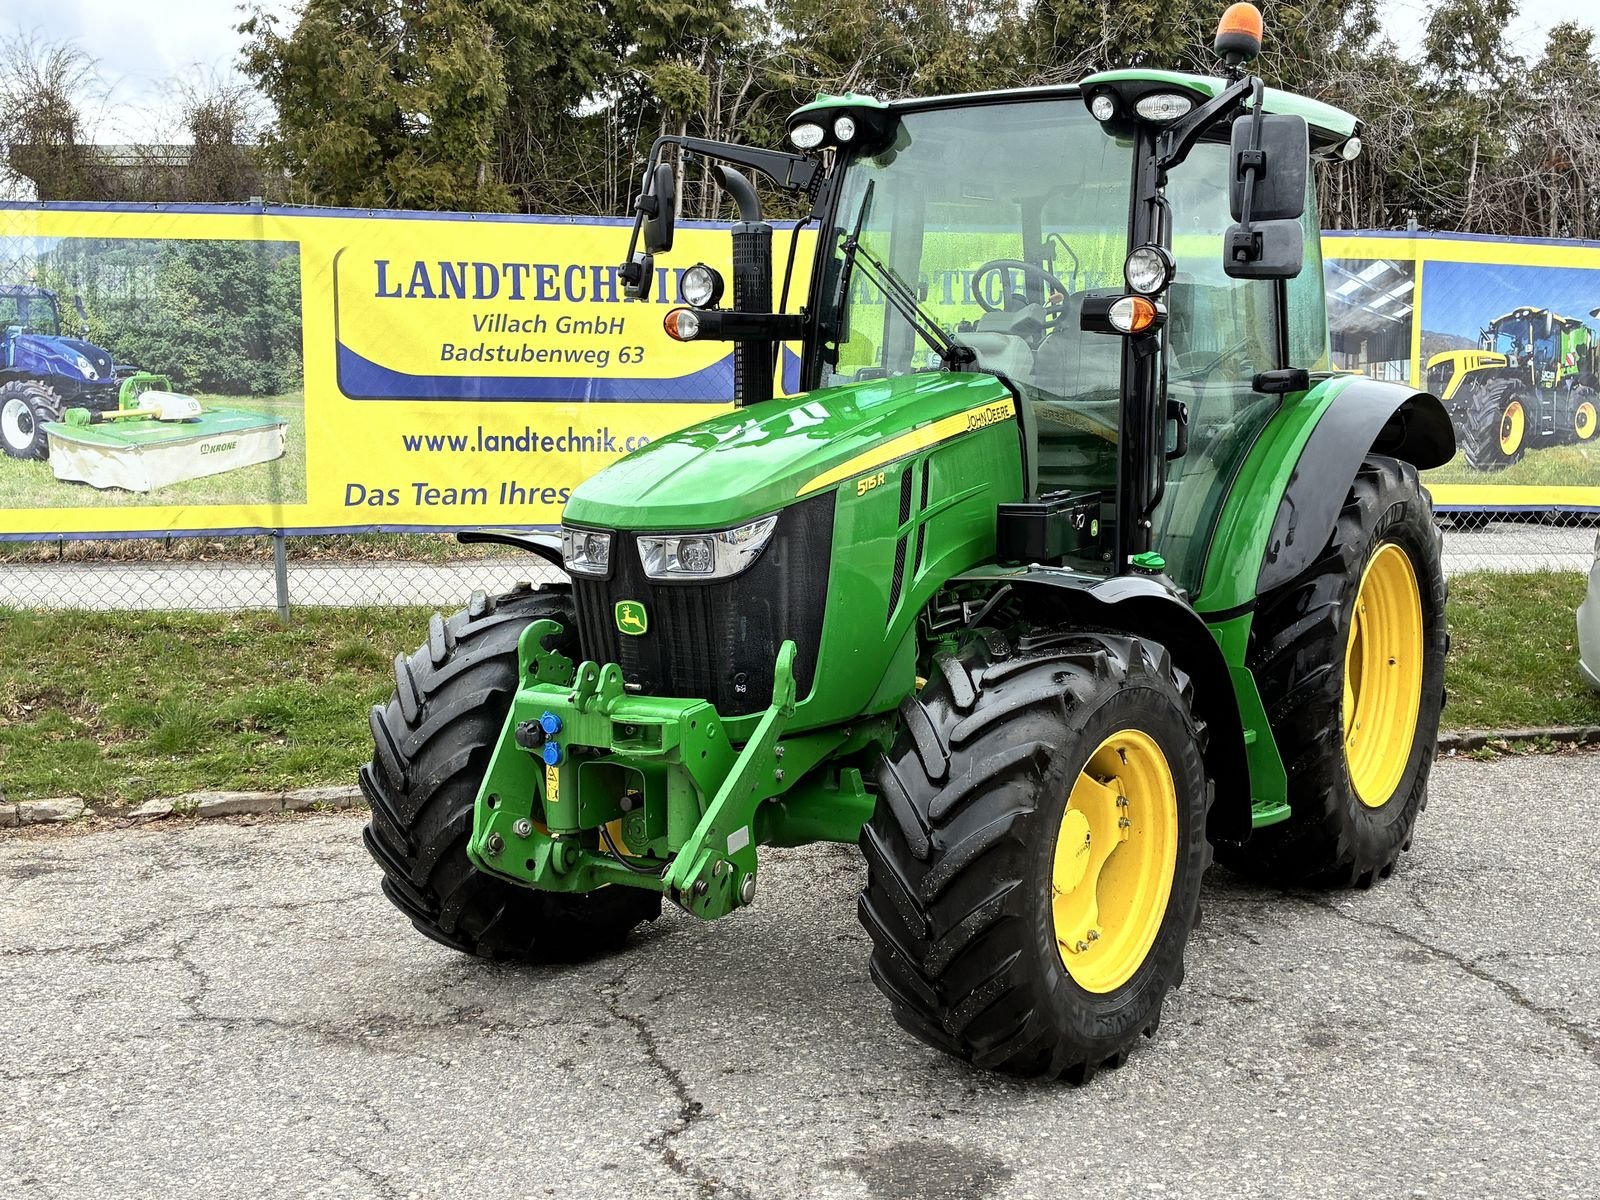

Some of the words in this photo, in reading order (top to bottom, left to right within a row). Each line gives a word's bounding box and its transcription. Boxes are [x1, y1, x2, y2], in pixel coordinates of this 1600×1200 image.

[373, 260, 687, 304] LANDTECHI
[473, 313, 547, 333] Villach
[556, 316, 625, 334] GmbH
[440, 343, 610, 368] Badstubenweg
[618, 346, 645, 364] 63
[210, 441, 238, 454] KRONE
[344, 483, 400, 507] Das
[411, 482, 488, 506] Team
[499, 481, 571, 505] Ihres
